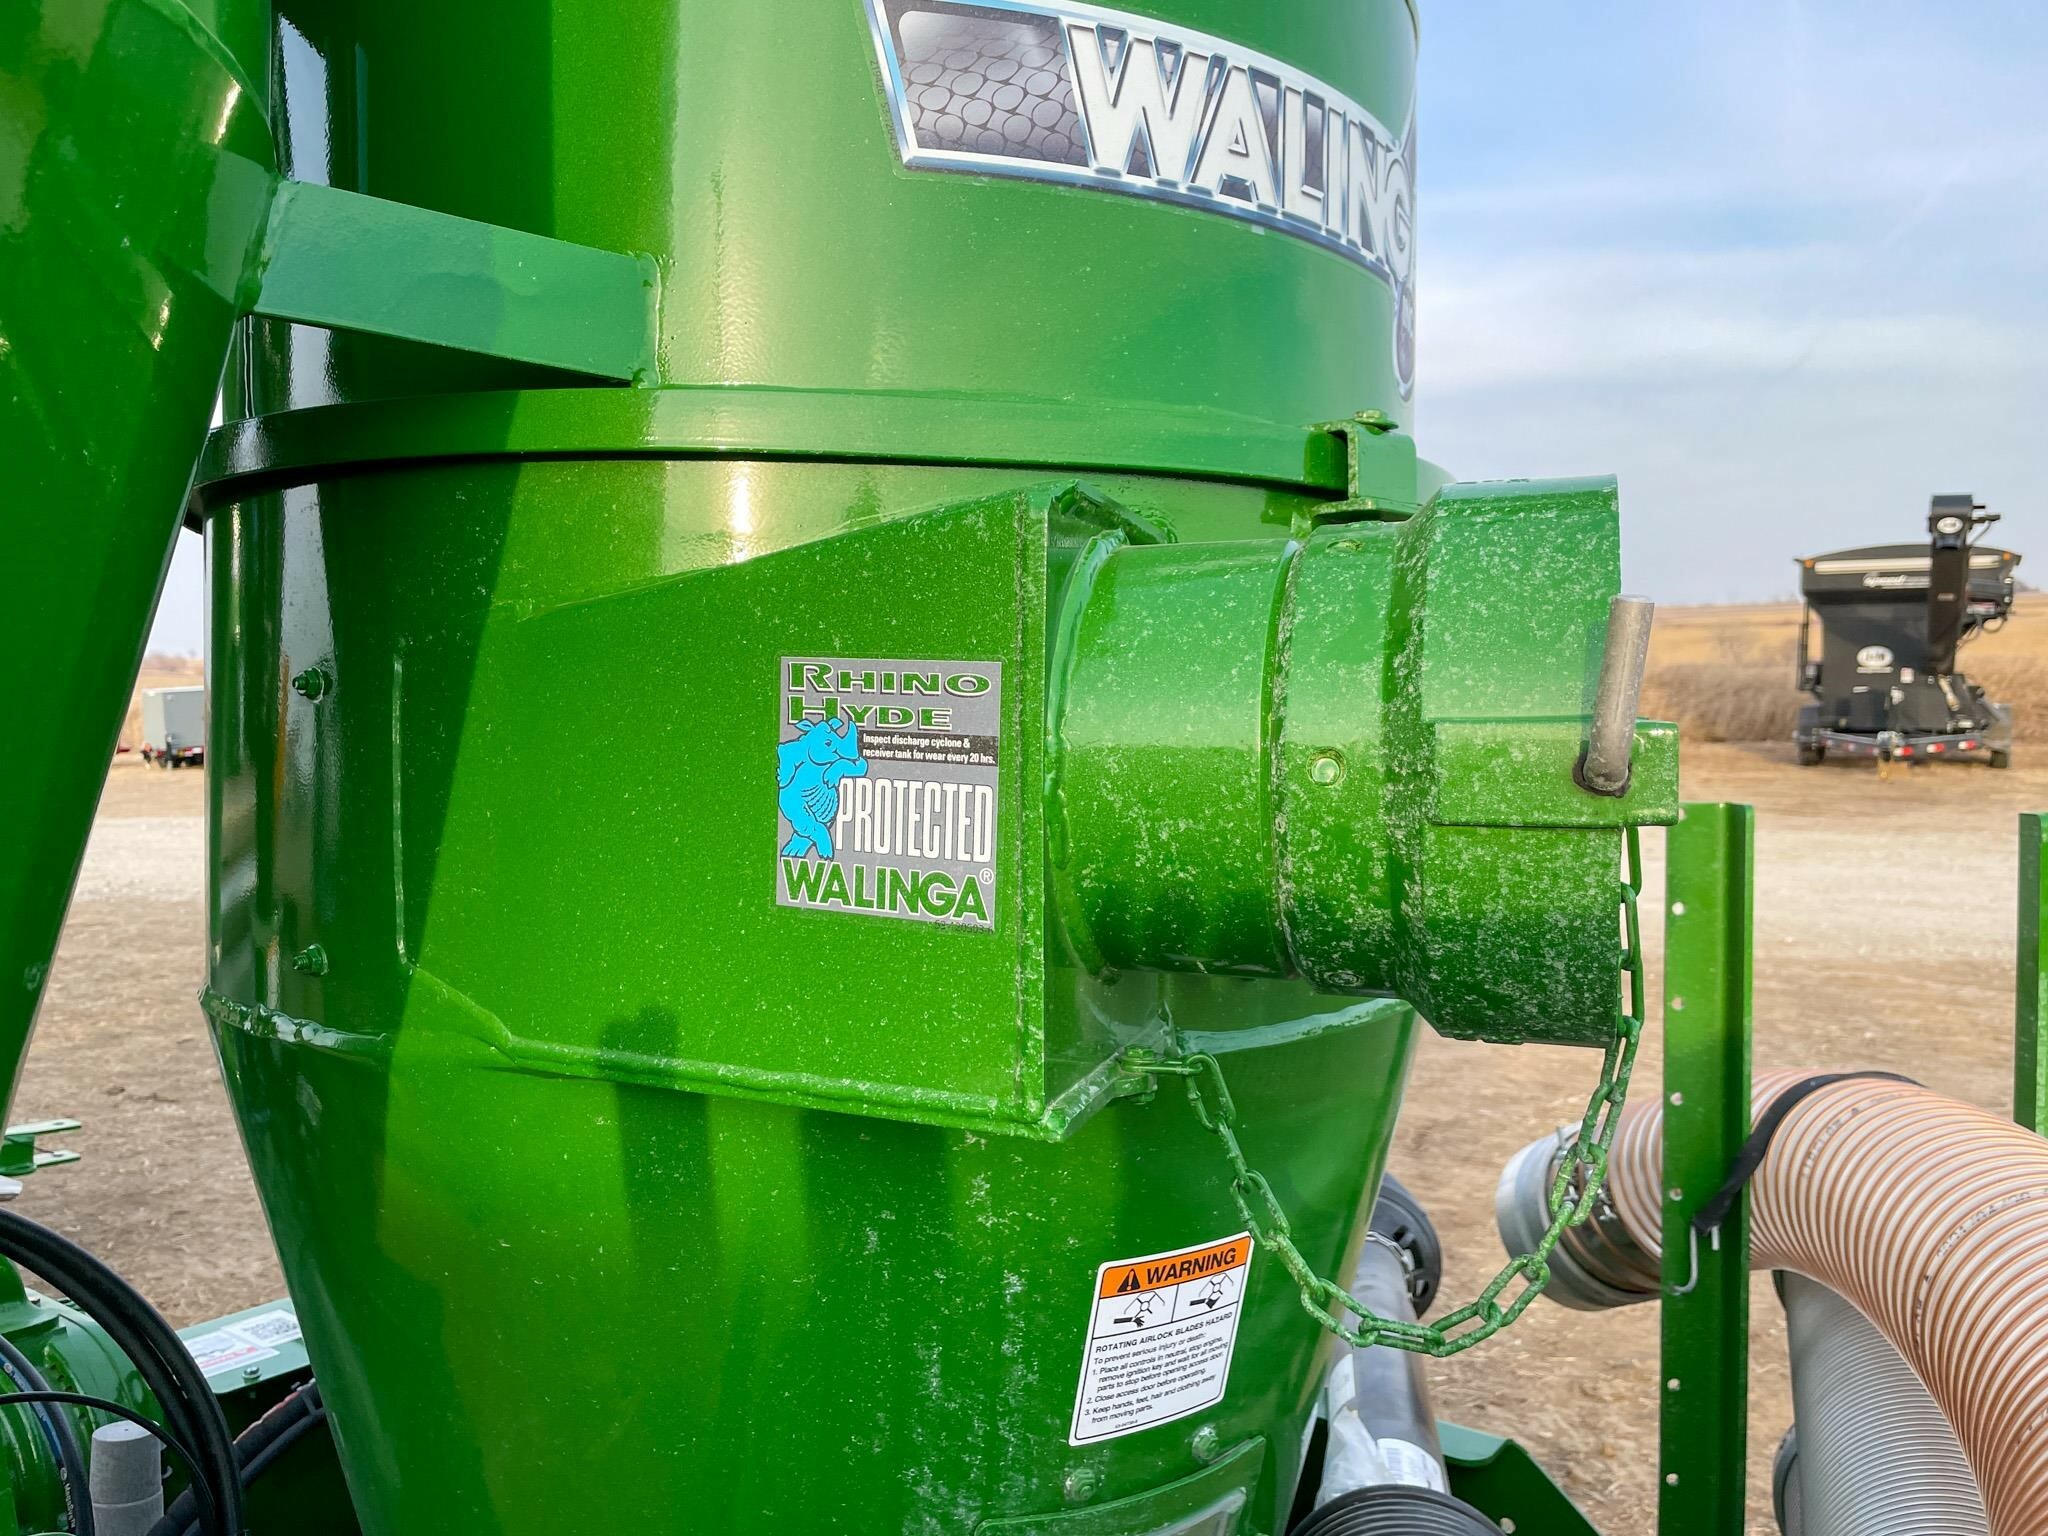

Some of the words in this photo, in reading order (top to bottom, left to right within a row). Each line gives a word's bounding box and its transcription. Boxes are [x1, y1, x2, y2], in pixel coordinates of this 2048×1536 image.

[788, 661, 992, 697] RHINO
[787, 695, 953, 731] HYDE
[862, 747, 895, 758] receiver
[895, 749, 912, 759] tank
[913, 749, 925, 760] for
[925, 752, 946, 761] wear
[946, 753, 969, 764] every
[969, 752, 980, 763] 20
[980, 753, 997, 764] hrs.
[863, 733, 891, 746] Inspect
[892, 734, 930, 749] discharge
[931, 736, 963, 749] cyclone
[963, 737, 971, 749] &
[835, 777, 994, 863] PROTECTED
[1145, 1247, 1237, 1285] WARNING
[1095, 1339, 1138, 1353] ROTATING
[1138, 1328, 1173, 1345] AIRLOCK
[1175, 1321, 1205, 1336] BLADES
[1205, 1312, 1233, 1327] HAZARD
[1094, 1357, 1103, 1365] To
[1104, 1352, 1131, 1365] prevent
[1131, 1346, 1157, 1357] serious
[1158, 1341, 1177, 1351] injury
[1098, 1372, 1126, 1383] remove
[1125, 1366, 1151, 1378] ignition
[1151, 1363, 1164, 1372] key
[1163, 1358, 1177, 1368] and
[1177, 1354, 1190, 1363] wait
[1190, 1352, 1200, 1360] for
[1199, 1348, 1208, 1357] all
[1207, 1340, 1229, 1353] moving
[1099, 1365, 1119, 1375] Place
[1119, 1362, 1129, 1371] all
[1129, 1356, 1156, 1368] controls
[1188, 1343, 1203, 1352] stop
[1094, 1393, 1115, 1402] Close
[1115, 1387, 1139, 1398] access
[1139, 1382, 1156, 1392] door
[1156, 1376, 1177, 1387] before
[1096, 1382, 1115, 1393] parts
[1116, 1380, 1124, 1388] to
[1124, 1377, 1140, 1386] stop
[1140, 1371, 1162, 1382] before
[1162, 1364, 1188, 1376] opening
[1188, 1356, 1209, 1368] access
[1092, 1405, 1111, 1415] Keep
[1150, 1391, 1164, 1400] hair
[1163, 1387, 1177, 1396] and
[1177, 1379, 1201, 1393] clothing
[1201, 1373, 1217, 1384] away
[1091, 1415, 1109, 1424] from
[1108, 1408, 1135, 1419] moving
